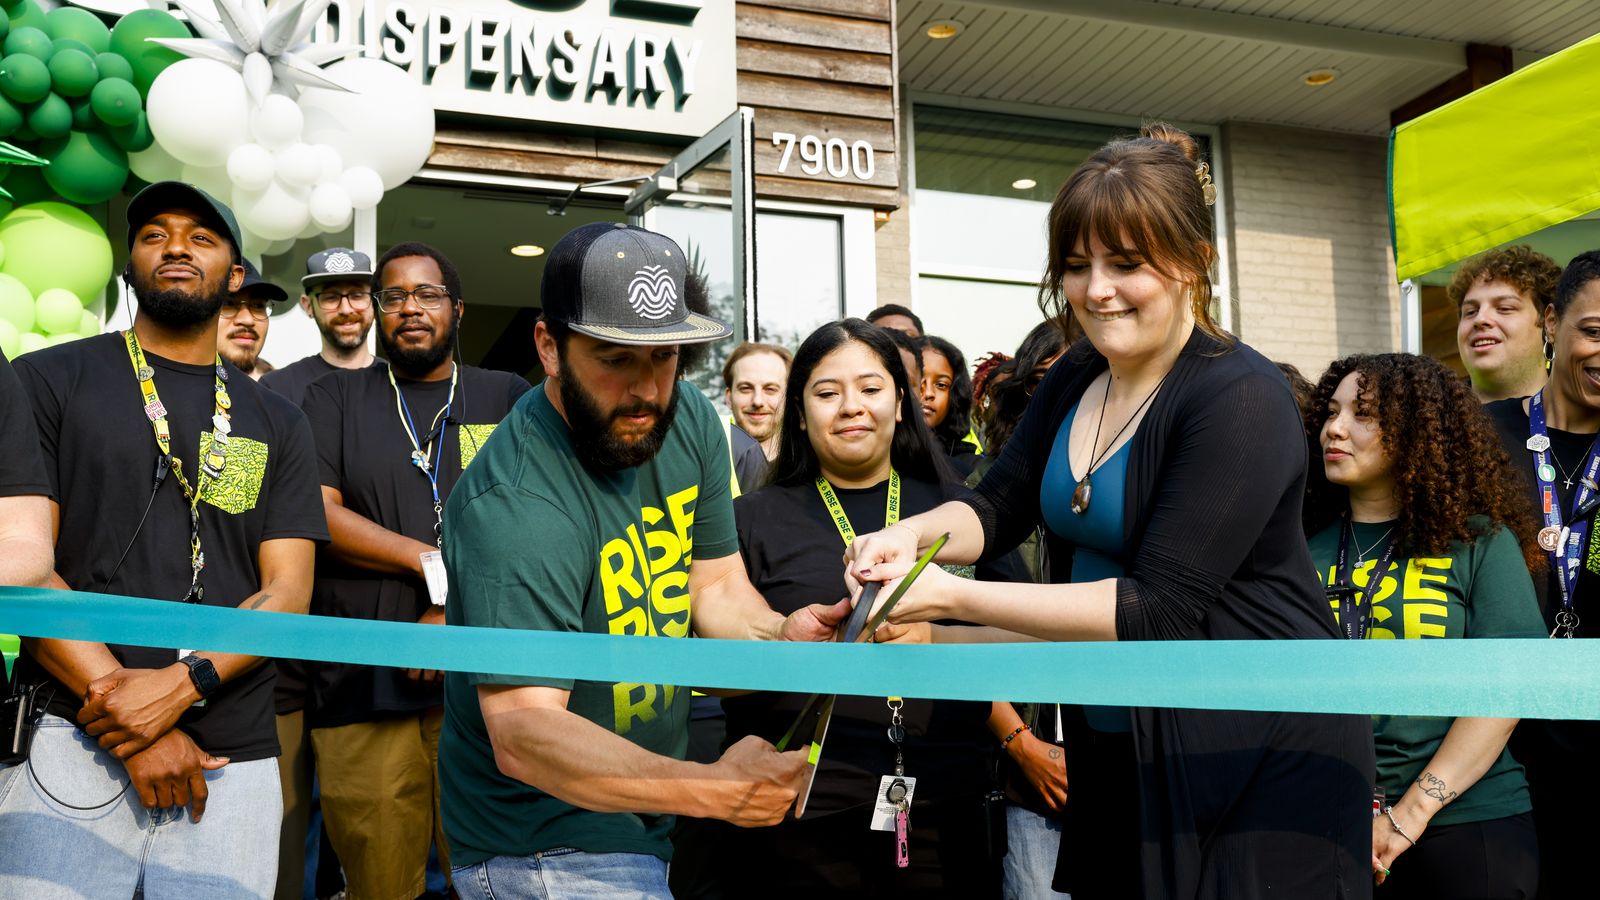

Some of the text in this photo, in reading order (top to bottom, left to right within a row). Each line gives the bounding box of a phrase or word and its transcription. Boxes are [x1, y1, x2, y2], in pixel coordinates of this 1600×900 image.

[311, 0, 704, 102] DISPENSARY
[772, 131, 876, 181] 7900
[129, 341, 140, 357] RISE
[824, 490, 837, 507] RISE
[836, 515, 850, 533] RISE
[600, 484, 699, 615] RISE
